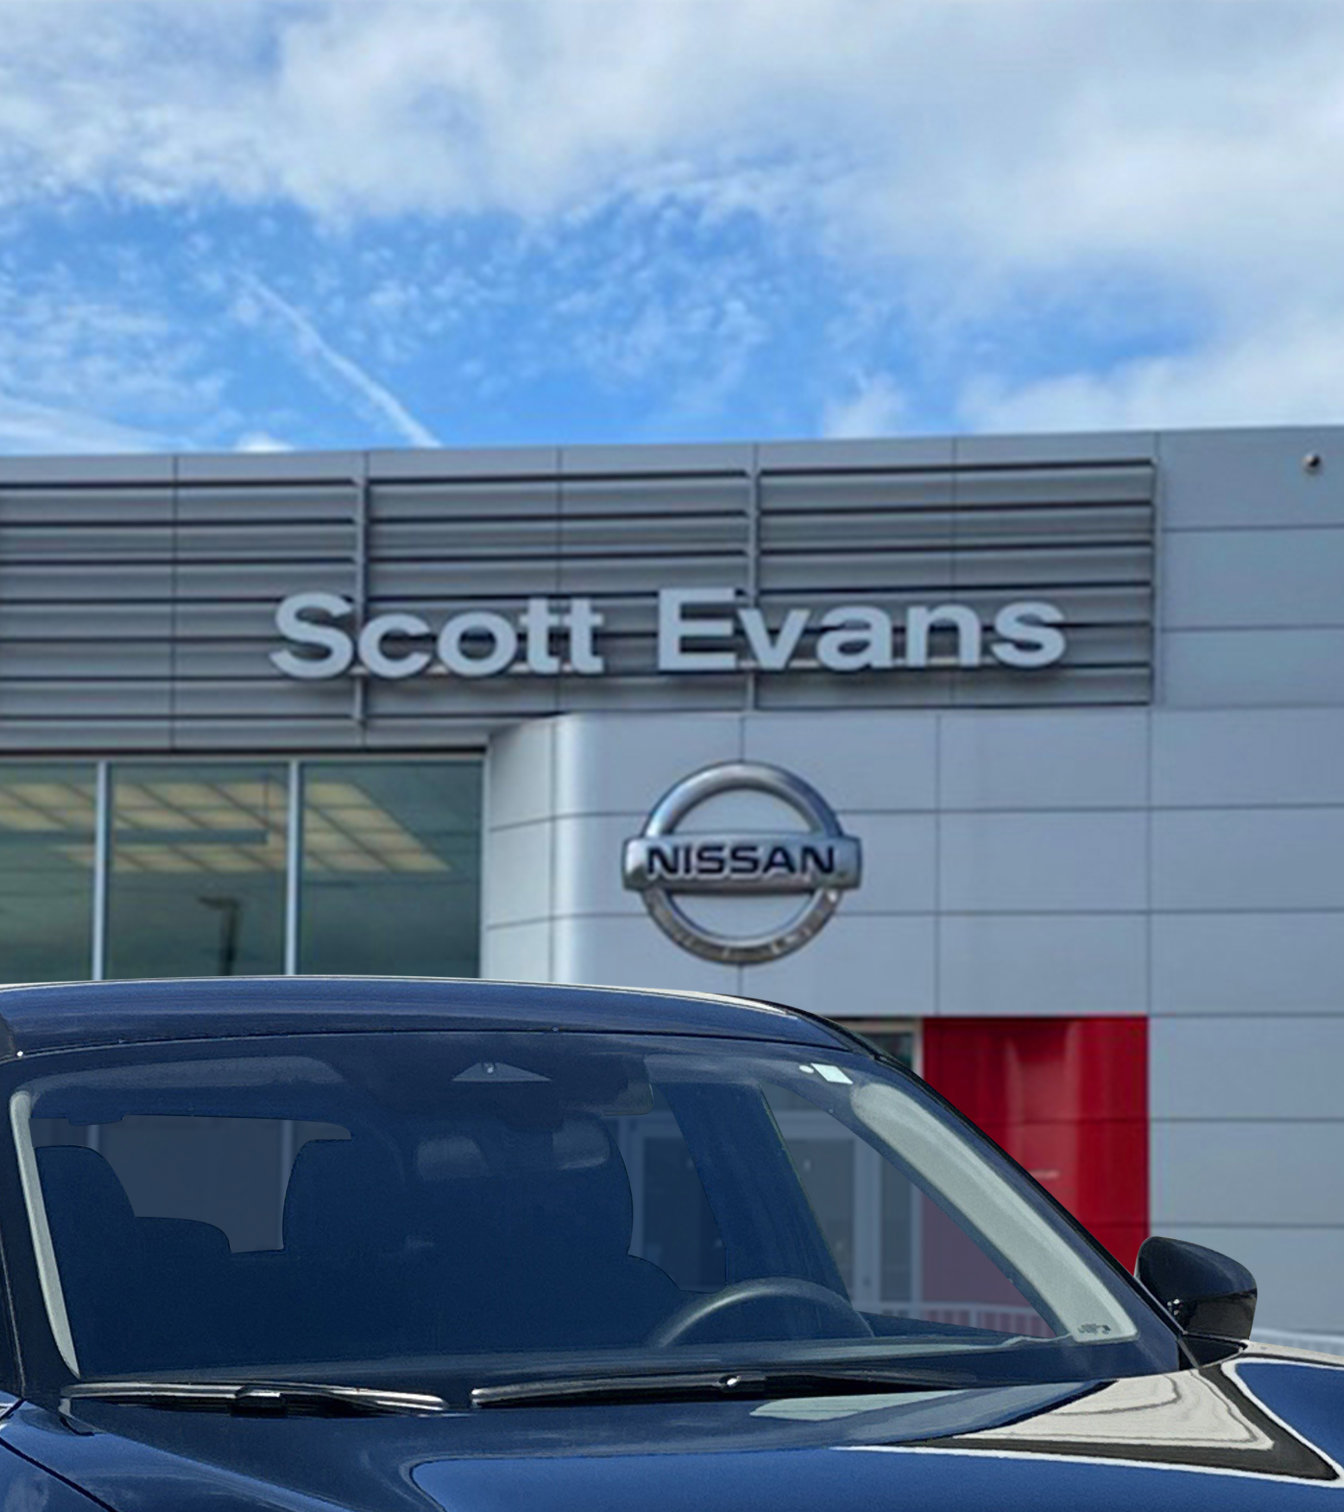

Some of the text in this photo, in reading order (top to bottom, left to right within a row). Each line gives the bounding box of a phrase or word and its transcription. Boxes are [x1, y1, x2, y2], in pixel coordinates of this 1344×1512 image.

[269, 586, 1068, 679] Scott Evans
[645, 844, 838, 879] NISSAN
